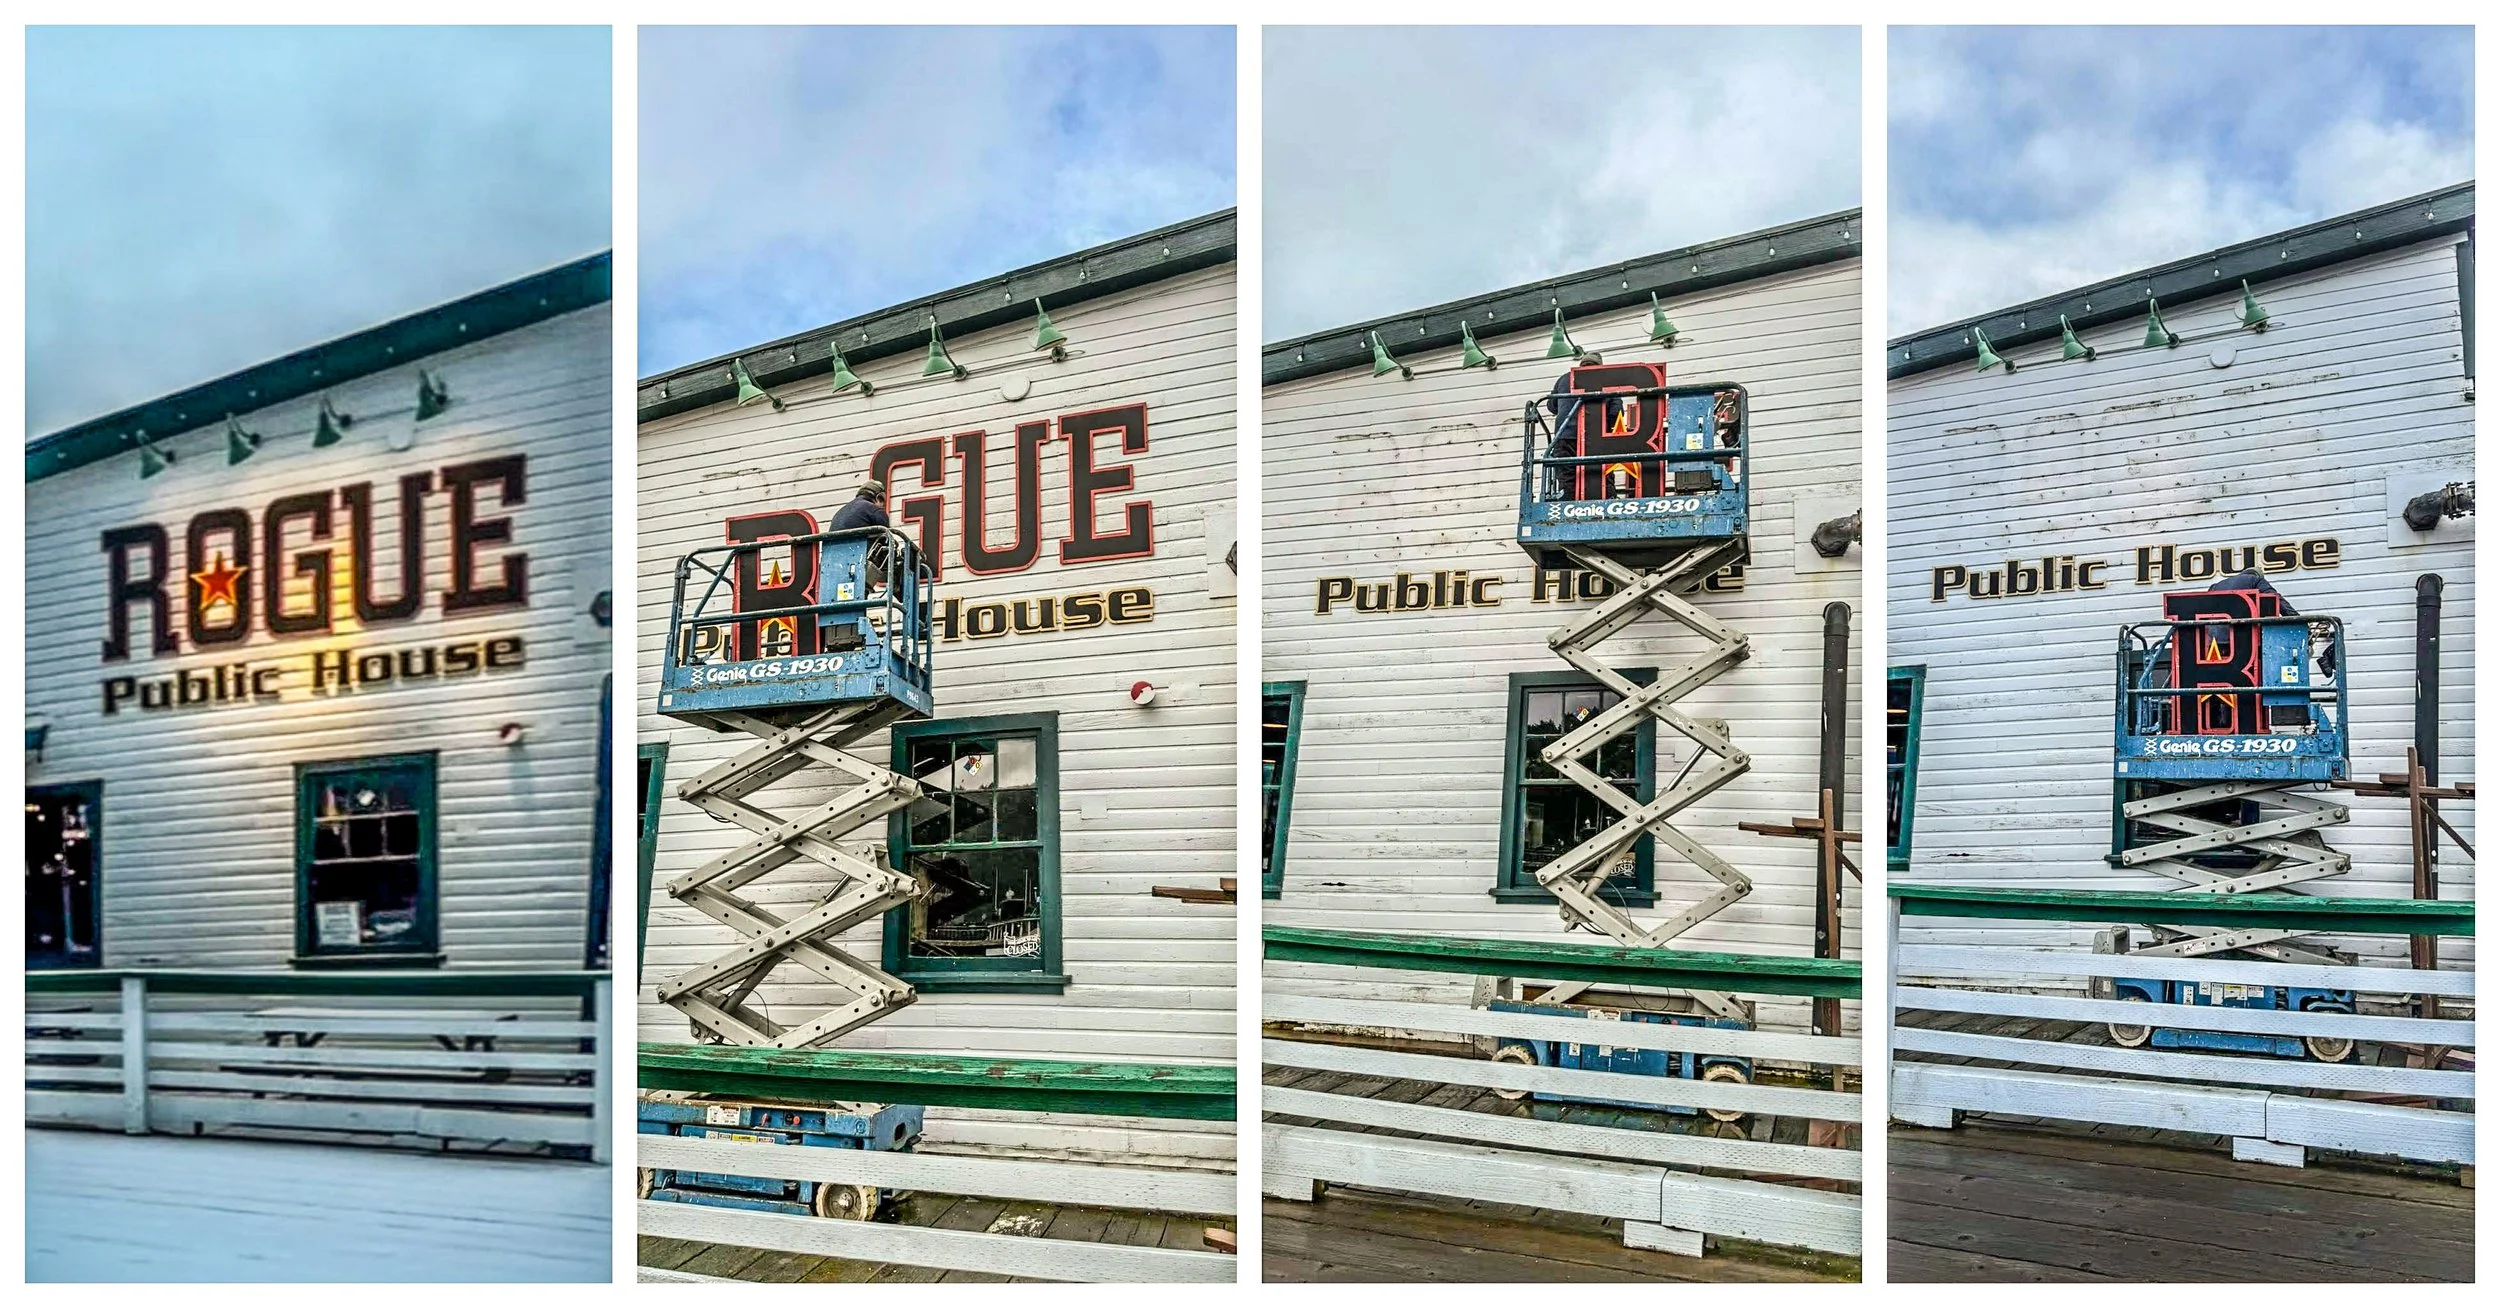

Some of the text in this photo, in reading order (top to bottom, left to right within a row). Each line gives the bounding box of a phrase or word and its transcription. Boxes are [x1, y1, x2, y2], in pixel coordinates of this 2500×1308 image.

[1564, 498, 1701, 519] Genie GS-1930
[102, 453, 530, 662] ROGUE
[1930, 536, 2342, 604] Public House
[1313, 568, 1504, 616] Public
[102, 634, 526, 716] Public House
[706, 655, 844, 684] Genie GS-1930
[2159, 738, 2298, 758] Genie GS-1930
[1610, 863, 1634, 875] LOSED
[1006, 941, 1038, 956] CLOSED
